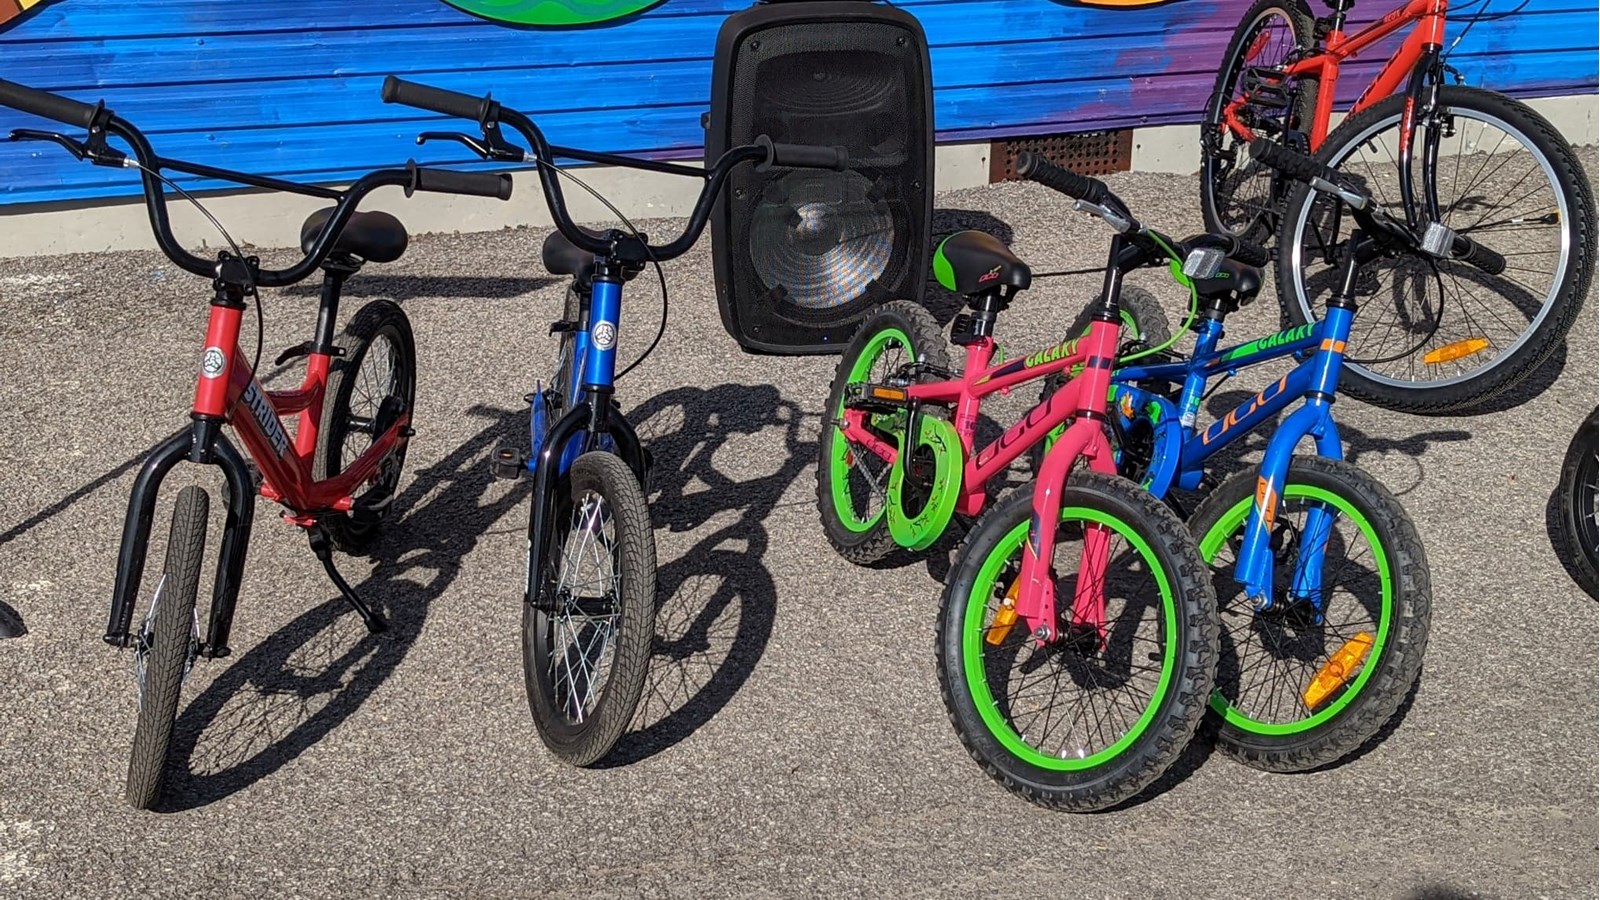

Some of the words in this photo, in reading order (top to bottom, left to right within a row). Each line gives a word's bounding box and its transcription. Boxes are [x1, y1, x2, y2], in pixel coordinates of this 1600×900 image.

[1258, 322, 1316, 350] GALAXY
[1024, 338, 1079, 368] GALAXY
[243, 382, 289, 458] STRIDER
